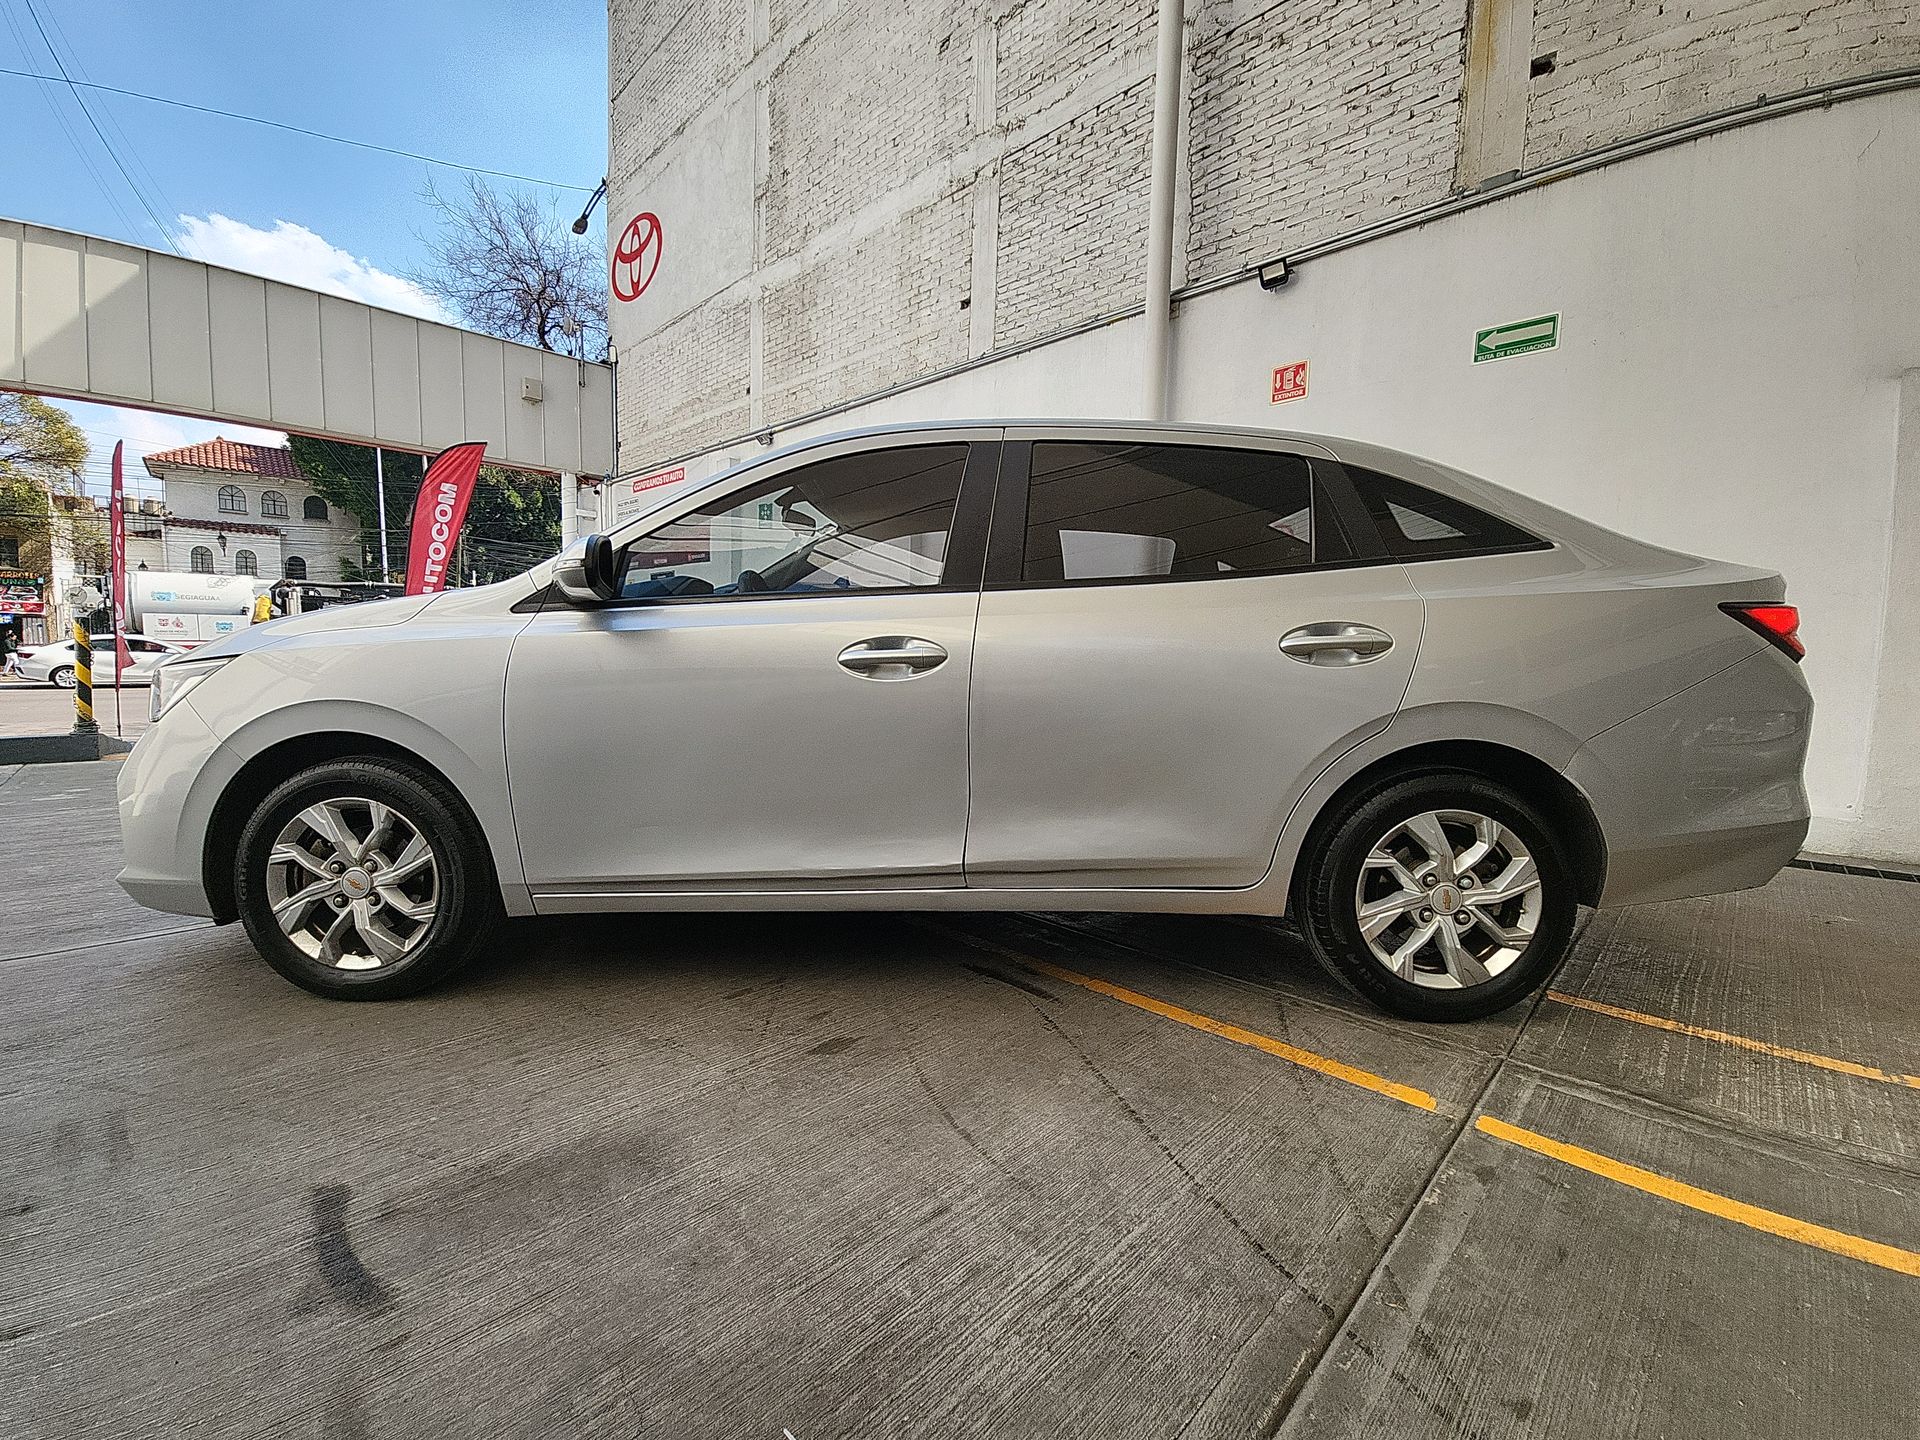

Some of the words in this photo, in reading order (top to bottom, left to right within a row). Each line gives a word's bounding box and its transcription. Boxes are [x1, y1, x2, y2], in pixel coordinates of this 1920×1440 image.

[1477, 354, 1495, 362] RUTA
[1496, 350, 1505, 358] DE
[1506, 341, 1553, 356] EVACUACION
[1274, 389, 1304, 401] EXTINTOR
[633, 475, 663, 491] COMPRAMOS
[662, 473, 670, 484] TU
[669, 470, 684, 481] AUTO
